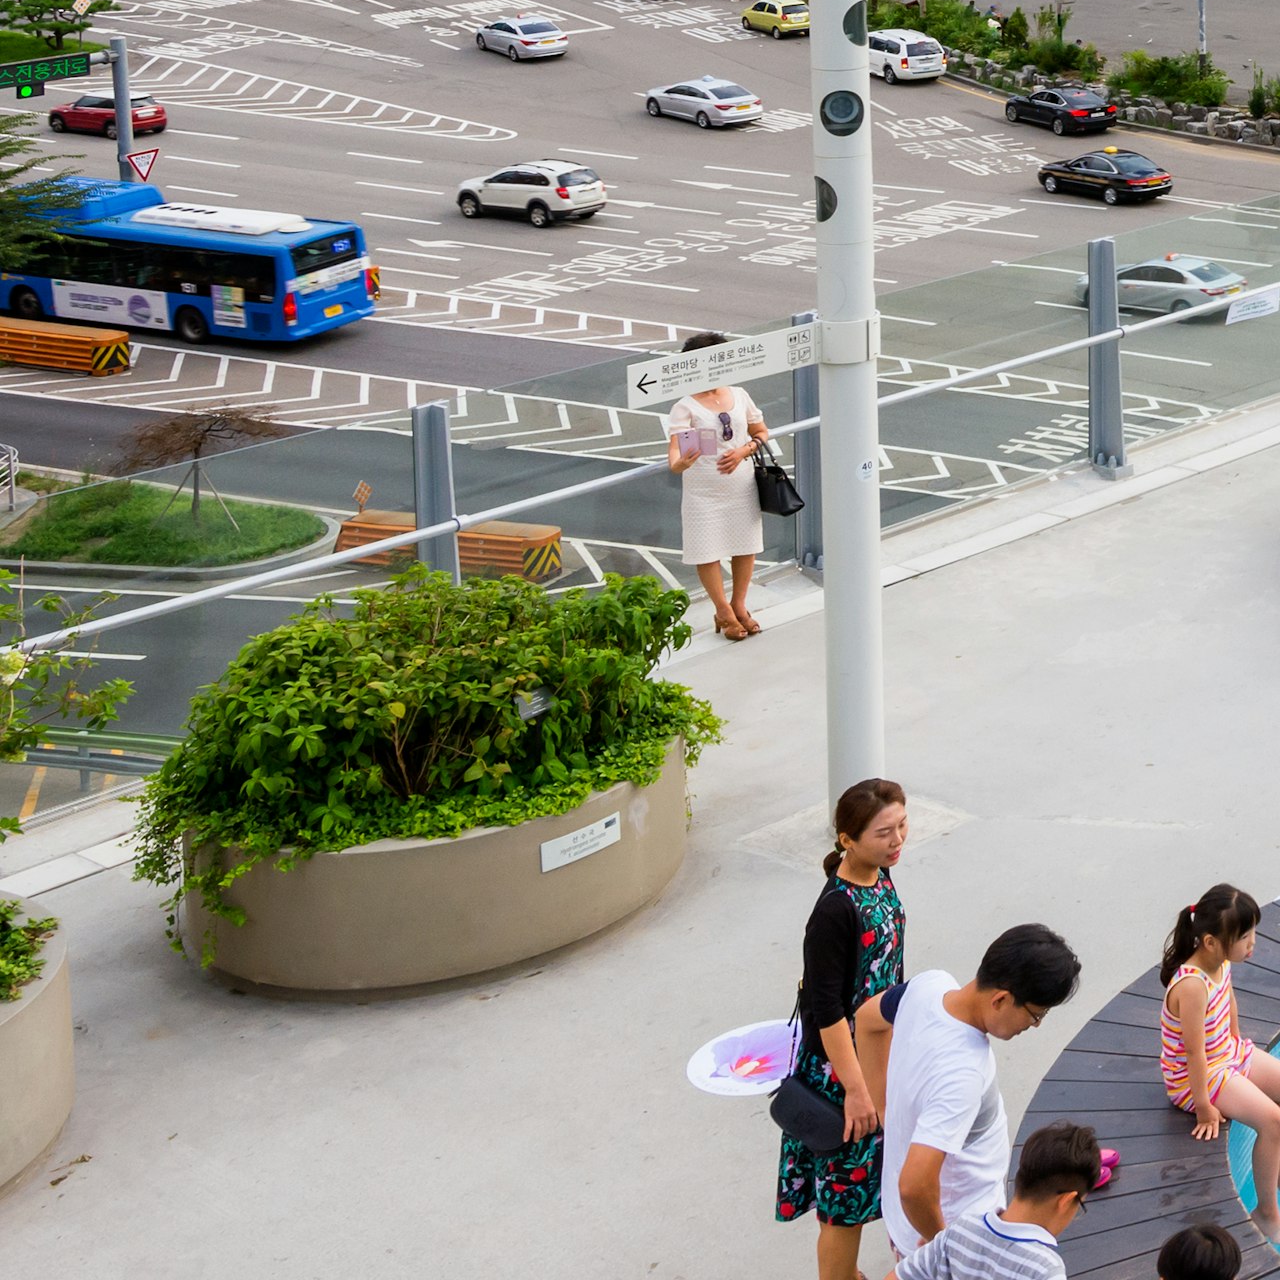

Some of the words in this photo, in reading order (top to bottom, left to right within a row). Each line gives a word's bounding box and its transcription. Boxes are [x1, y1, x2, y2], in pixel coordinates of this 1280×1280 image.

[0, 57, 87, 85] 스전용차로
[874, 116, 974, 139] 서울역
[896, 134, 1036, 160] 롯데마트
[644, 229, 767, 254] 용산
[548, 248, 688, 278] 후암동
[446, 271, 607, 304] 퇴계로
[662, 357, 698, 374] 목련마당
[708, 349, 734, 363] 서울로
[737, 343, 765, 358] 안내소
[862, 461, 872, 470] 40
